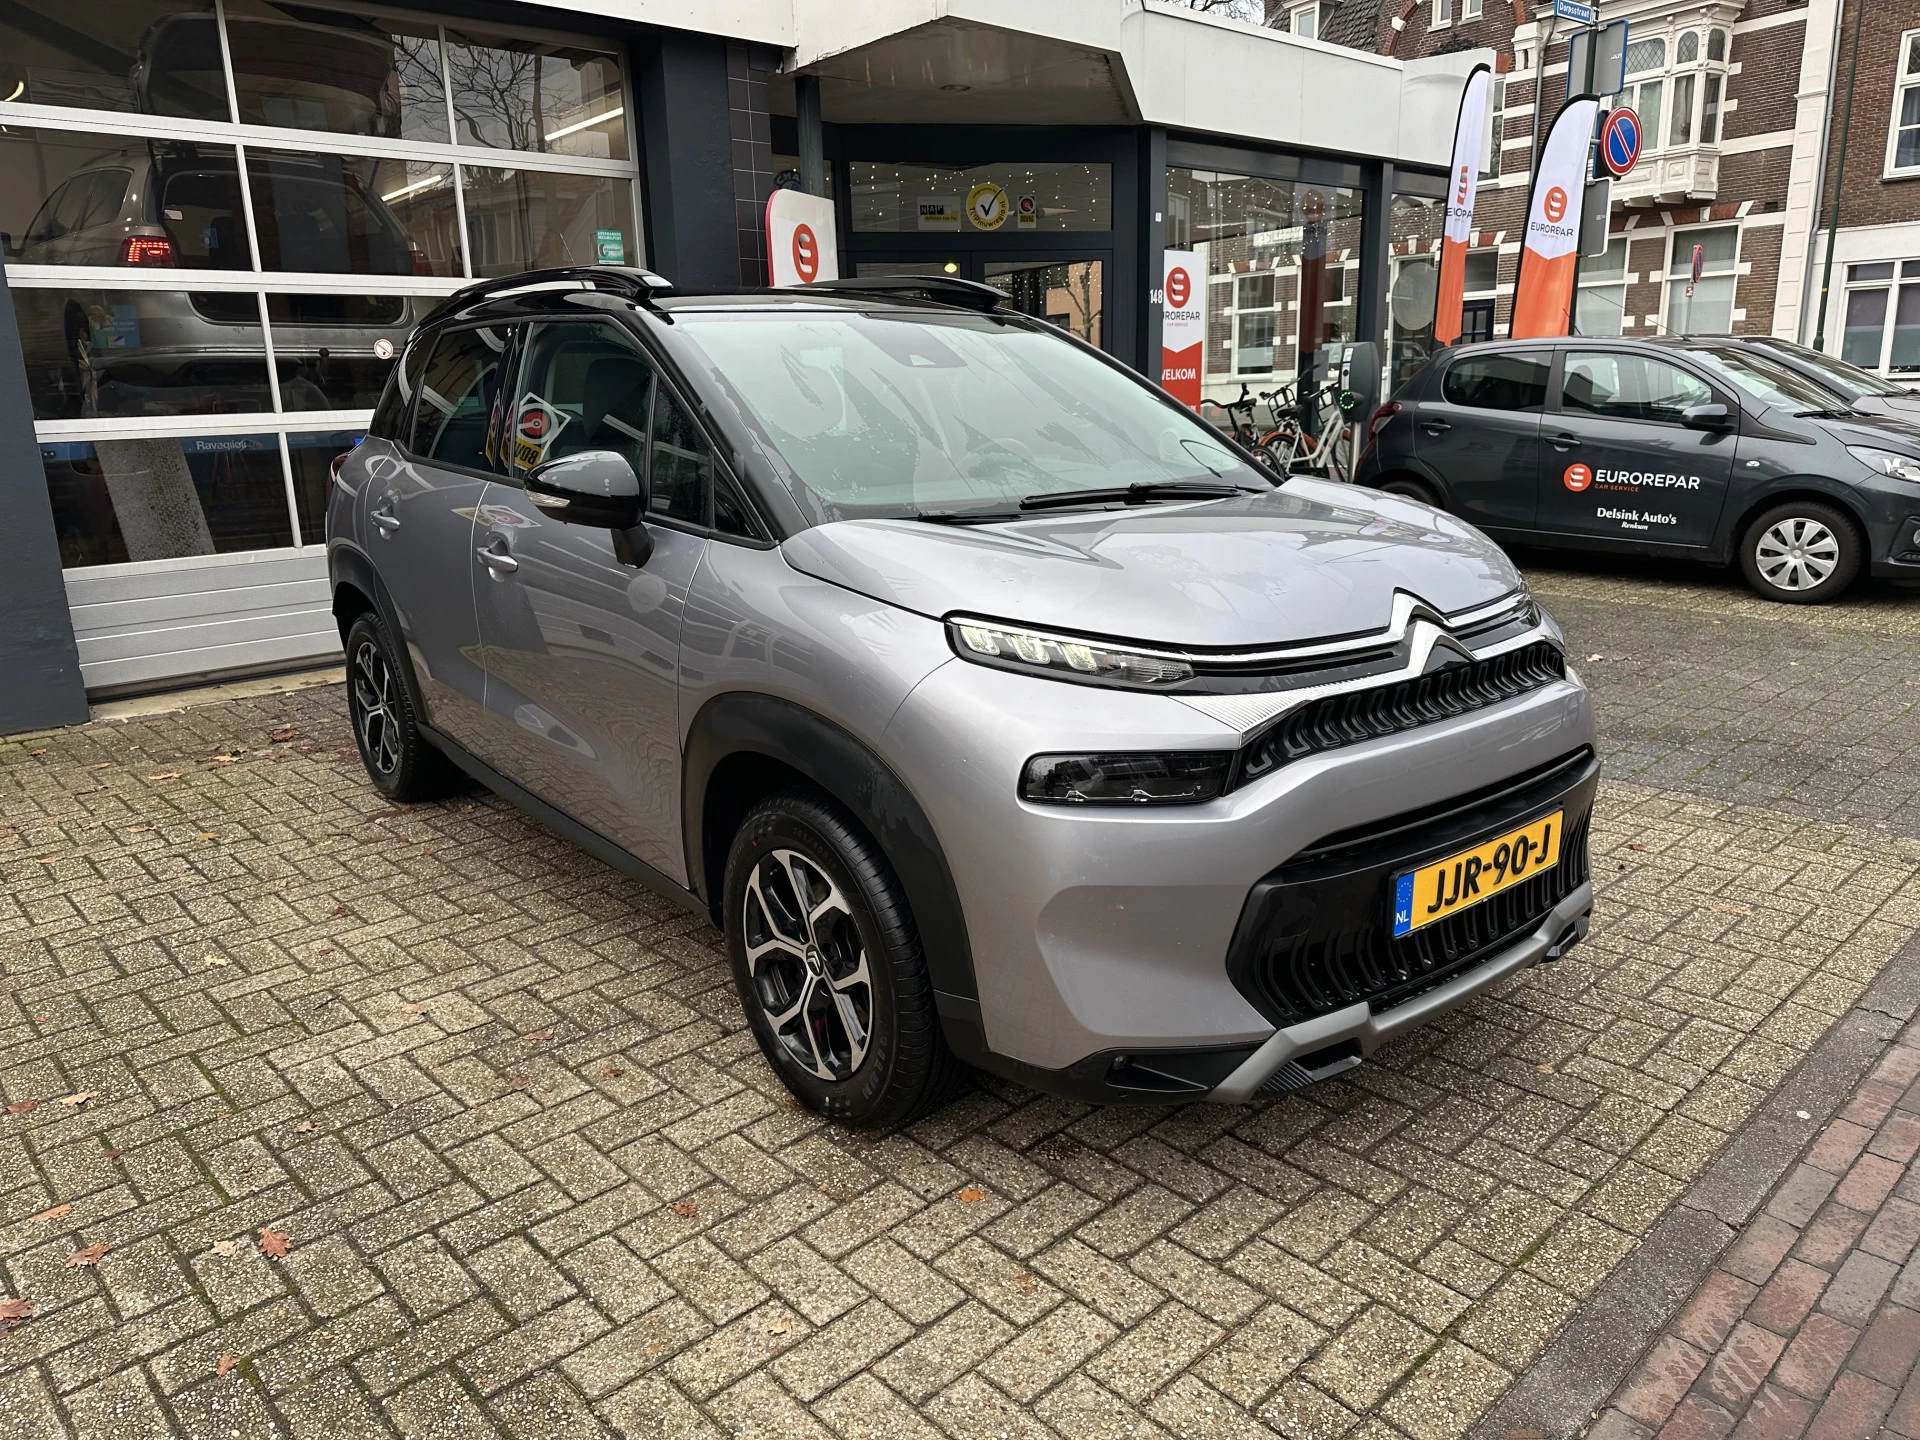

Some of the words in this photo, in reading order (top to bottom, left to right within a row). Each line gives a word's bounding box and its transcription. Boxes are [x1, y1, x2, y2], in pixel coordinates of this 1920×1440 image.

[1560, 1, 1590, 18] Dorpsstraat
[920, 205, 944, 215] NAP
[1150, 289, 1163, 304] 148
[1595, 469, 1700, 490] EUROREPAR
[1610, 485, 1639, 493] SERVICE
[1597, 507, 1639, 521] Delsink
[1642, 512, 1677, 525] Auto's
[1427, 823, 1551, 914] JJR-90-J
[1395, 910, 1409, 925] NL
